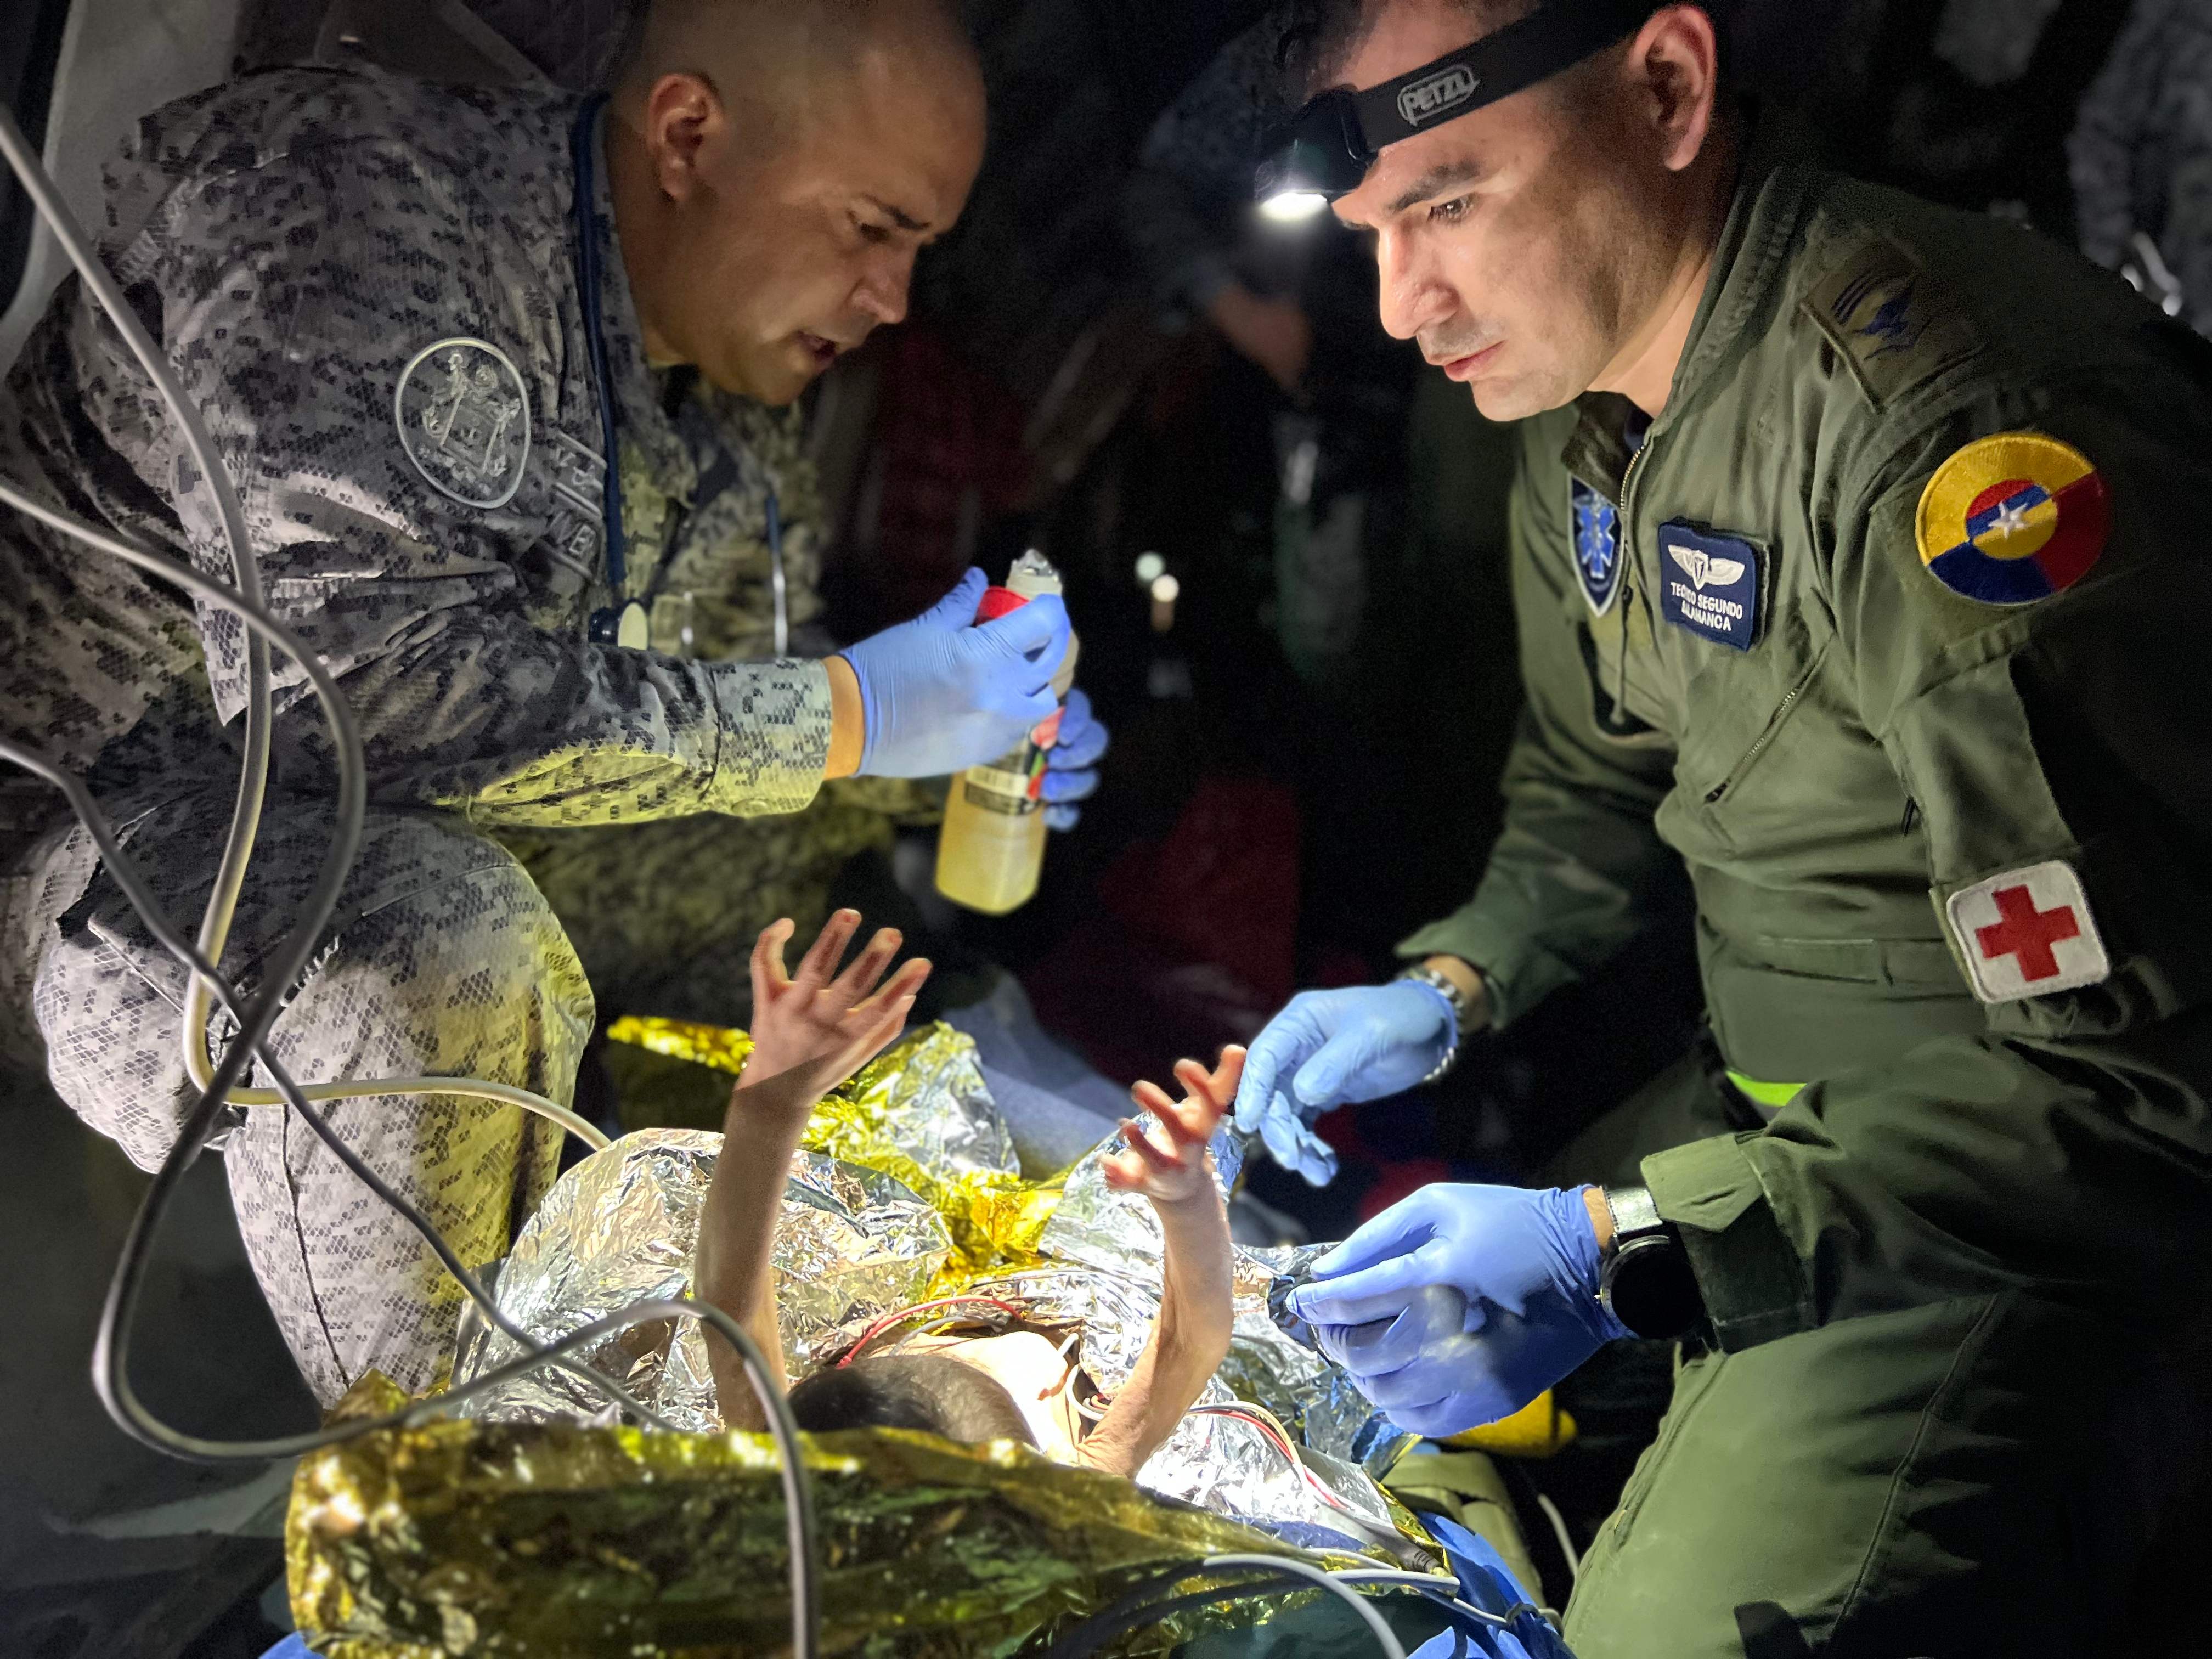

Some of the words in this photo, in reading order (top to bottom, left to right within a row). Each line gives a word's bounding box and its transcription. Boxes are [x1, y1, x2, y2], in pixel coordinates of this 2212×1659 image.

[1402, 70, 1480, 126] PETZL
[1671, 582, 1696, 605] TECO
[1697, 594, 1743, 620] SEGUNDO
